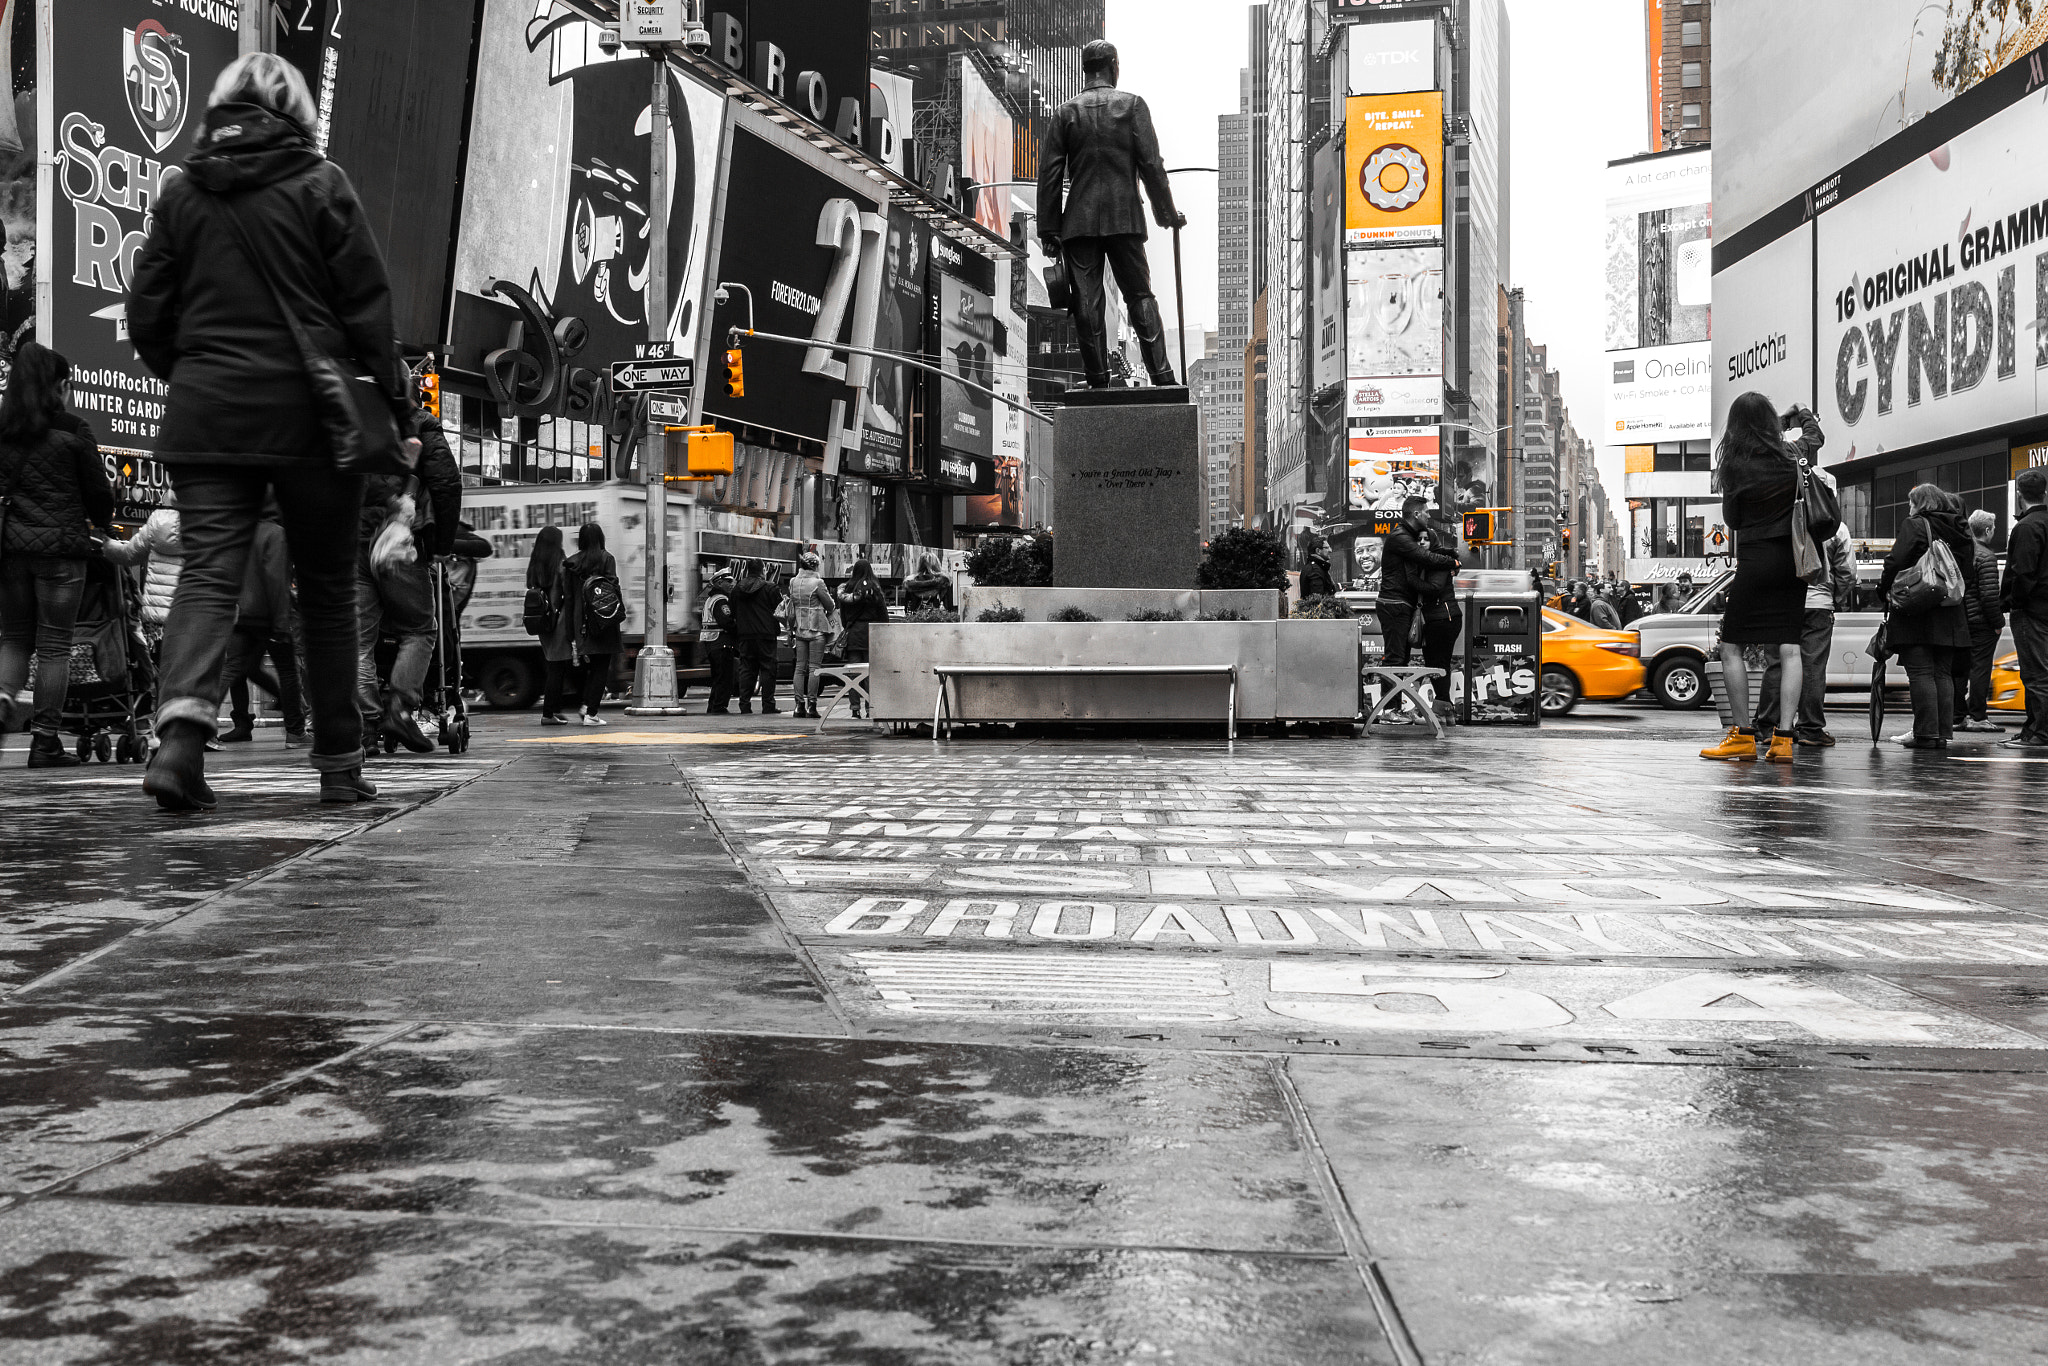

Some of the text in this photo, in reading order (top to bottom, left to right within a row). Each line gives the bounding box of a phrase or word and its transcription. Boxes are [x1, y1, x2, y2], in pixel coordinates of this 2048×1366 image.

[180, 0, 238, 32] ROCKING
[637, 6, 664, 15] SECURITY
[638, 26, 663, 35] CAMERA
[1376, 49, 1420, 65] TDK
[1391, 109, 1424, 120] SMILE.
[1375, 121, 1414, 131] REPEAT.
[1655, 170, 1676, 181] can
[1815, 174, 1841, 198] MARRIOTT
[1815, 189, 1839, 211] MARQUIS
[1360, 228, 1432, 240] DUNKIN' DONUTS
[1660, 219, 1698, 234] Except
[1835, 286, 1856, 323] 16
[1862, 243, 1956, 312] ORIGINAL
[770, 280, 821, 316] FOREVER21.COM
[635, 344, 645, 359] W
[648, 344, 665, 359] 46
[1834, 264, 2017, 428] CYNDI
[1727, 334, 1777, 382] swatch
[69, 364, 171, 398] hoolOfRockThe
[623, 367, 687, 383] ONE WAY
[73, 389, 123, 415] WINTER
[1639, 389, 1670, 399] Smoke
[652, 402, 683, 416] ONE WAY
[111, 418, 137, 436] 50TH
[140, 422, 147, 437] &
[1110, 468, 1137, 480] Grand
[1137, 467, 1154, 478] Old
[1155, 467, 1173, 479] Flag
[1104, 478, 1146, 489] Over There
[144, 488, 165, 504] NY
[1374, 511, 1403, 519] SON
[1493, 643, 1523, 654] TRASH
[940, 864, 1980, 912] SIMON
[822, 897, 1634, 954] BROADWAY
[1267, 960, 1950, 1044] 54
[1049, 1030, 1875, 1062] 54TH STREET
